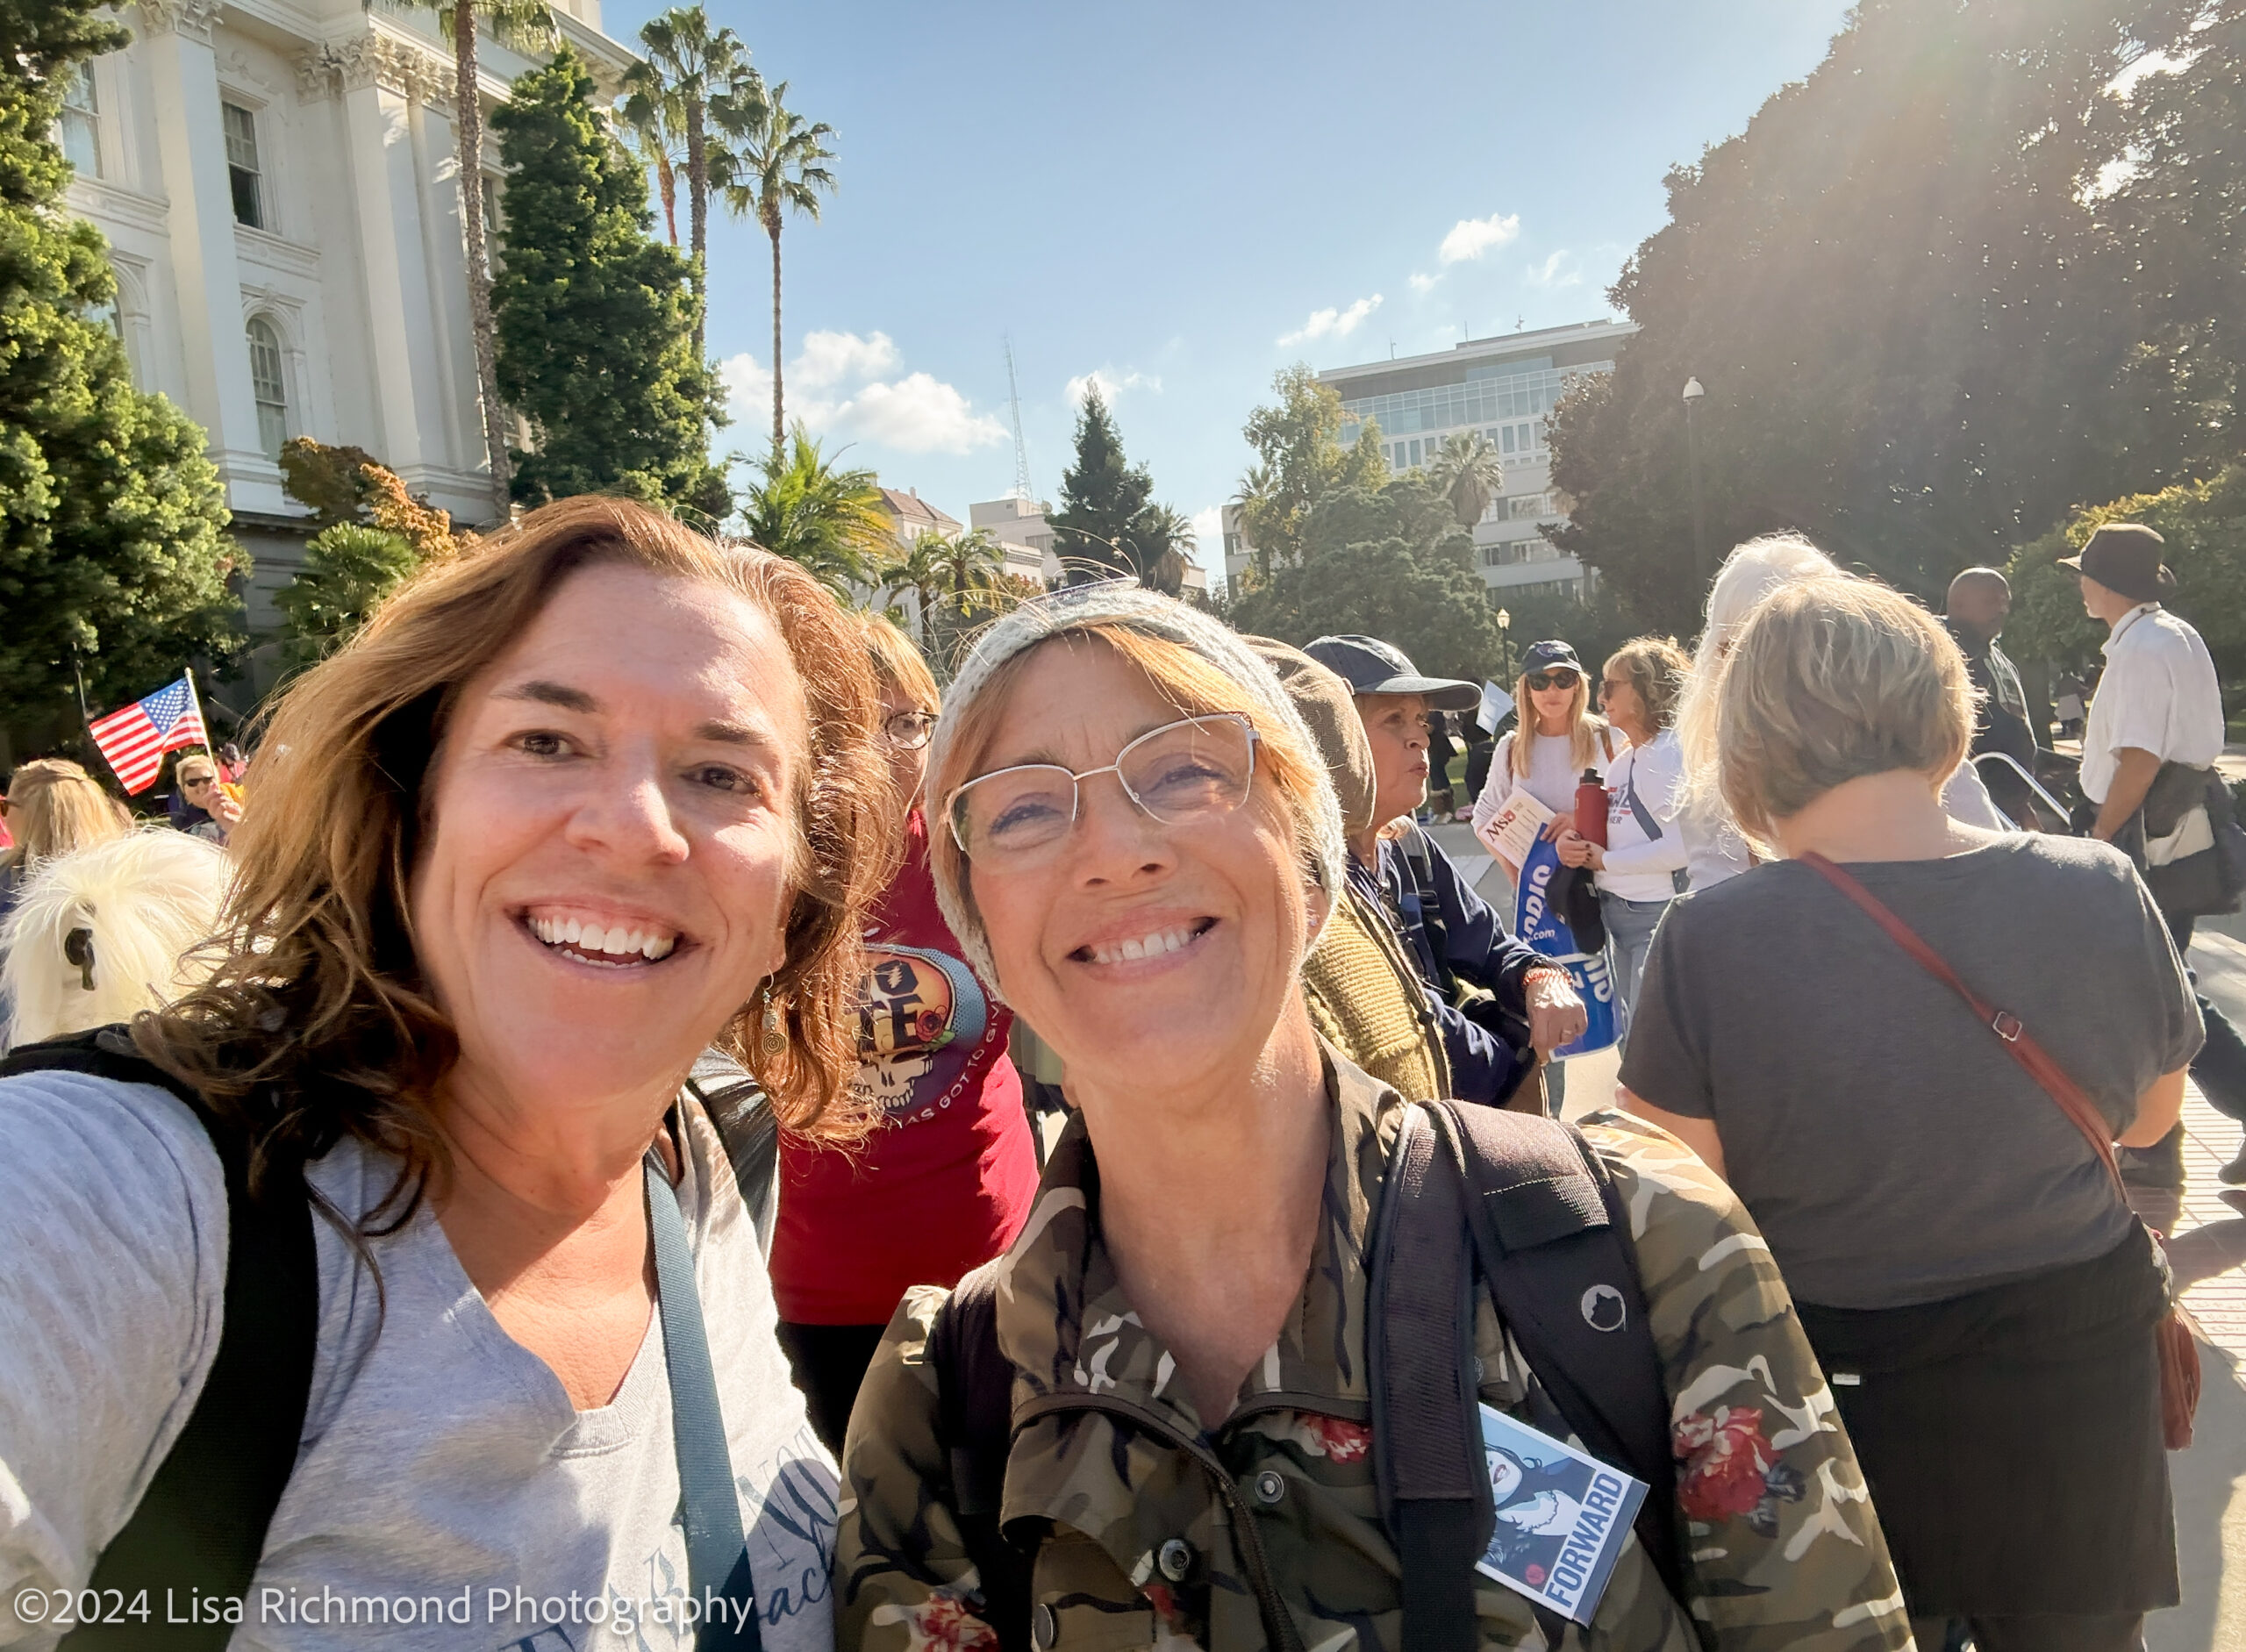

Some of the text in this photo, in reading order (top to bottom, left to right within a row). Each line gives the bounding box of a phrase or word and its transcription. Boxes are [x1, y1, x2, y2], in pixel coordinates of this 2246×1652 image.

[939, 1071, 969, 1109] GOT
[967, 1048, 985, 1068] TO
[1546, 1473, 1622, 1607] FORWARD
